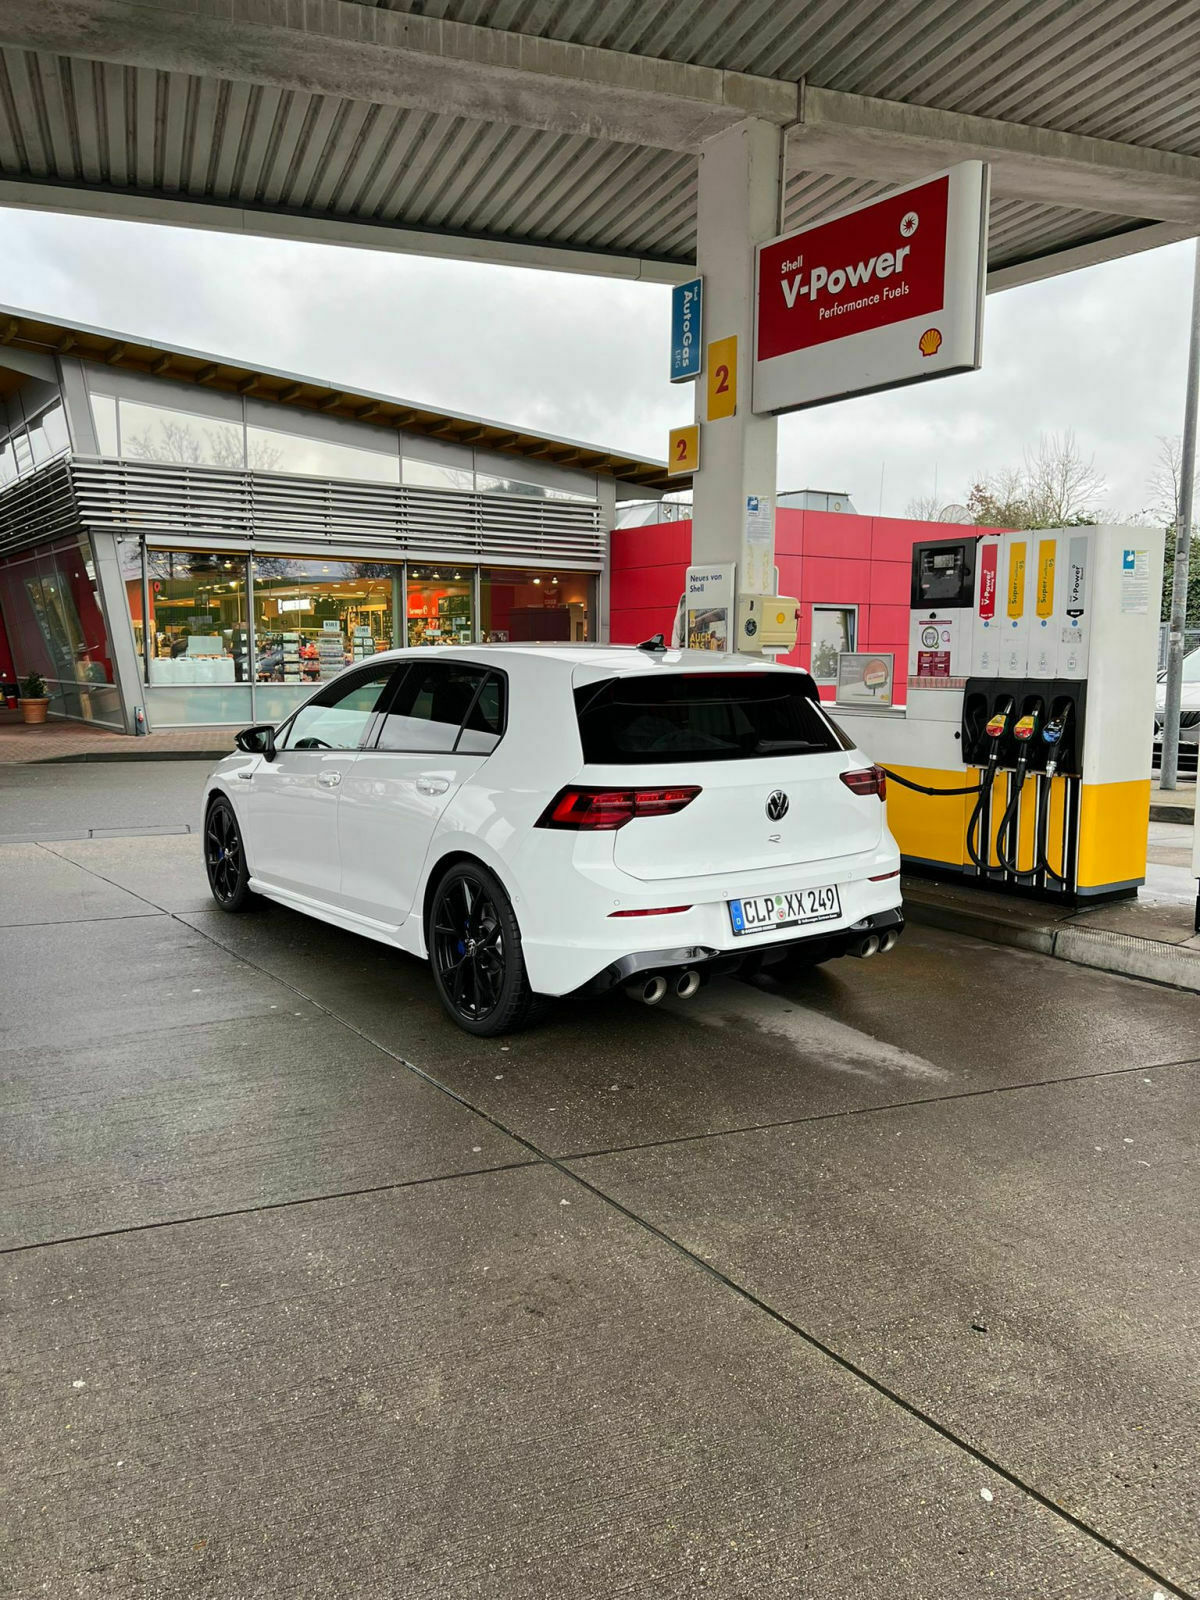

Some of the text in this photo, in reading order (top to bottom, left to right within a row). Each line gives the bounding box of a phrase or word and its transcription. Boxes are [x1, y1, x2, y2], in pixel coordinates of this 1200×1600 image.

[781, 254, 803, 274] Shell
[781, 245, 911, 308] V-Power
[819, 281, 909, 320] Performance Fuels
[682, 290, 693, 367] AutoGas
[715, 364, 729, 395] 2
[676, 439, 687, 461] 2
[690, 584, 704, 592] Shell
[1072, 565, 1080, 602] V-Power
[690, 632, 711, 642] AUCH
[743, 888, 835, 924] CLP XX 249
